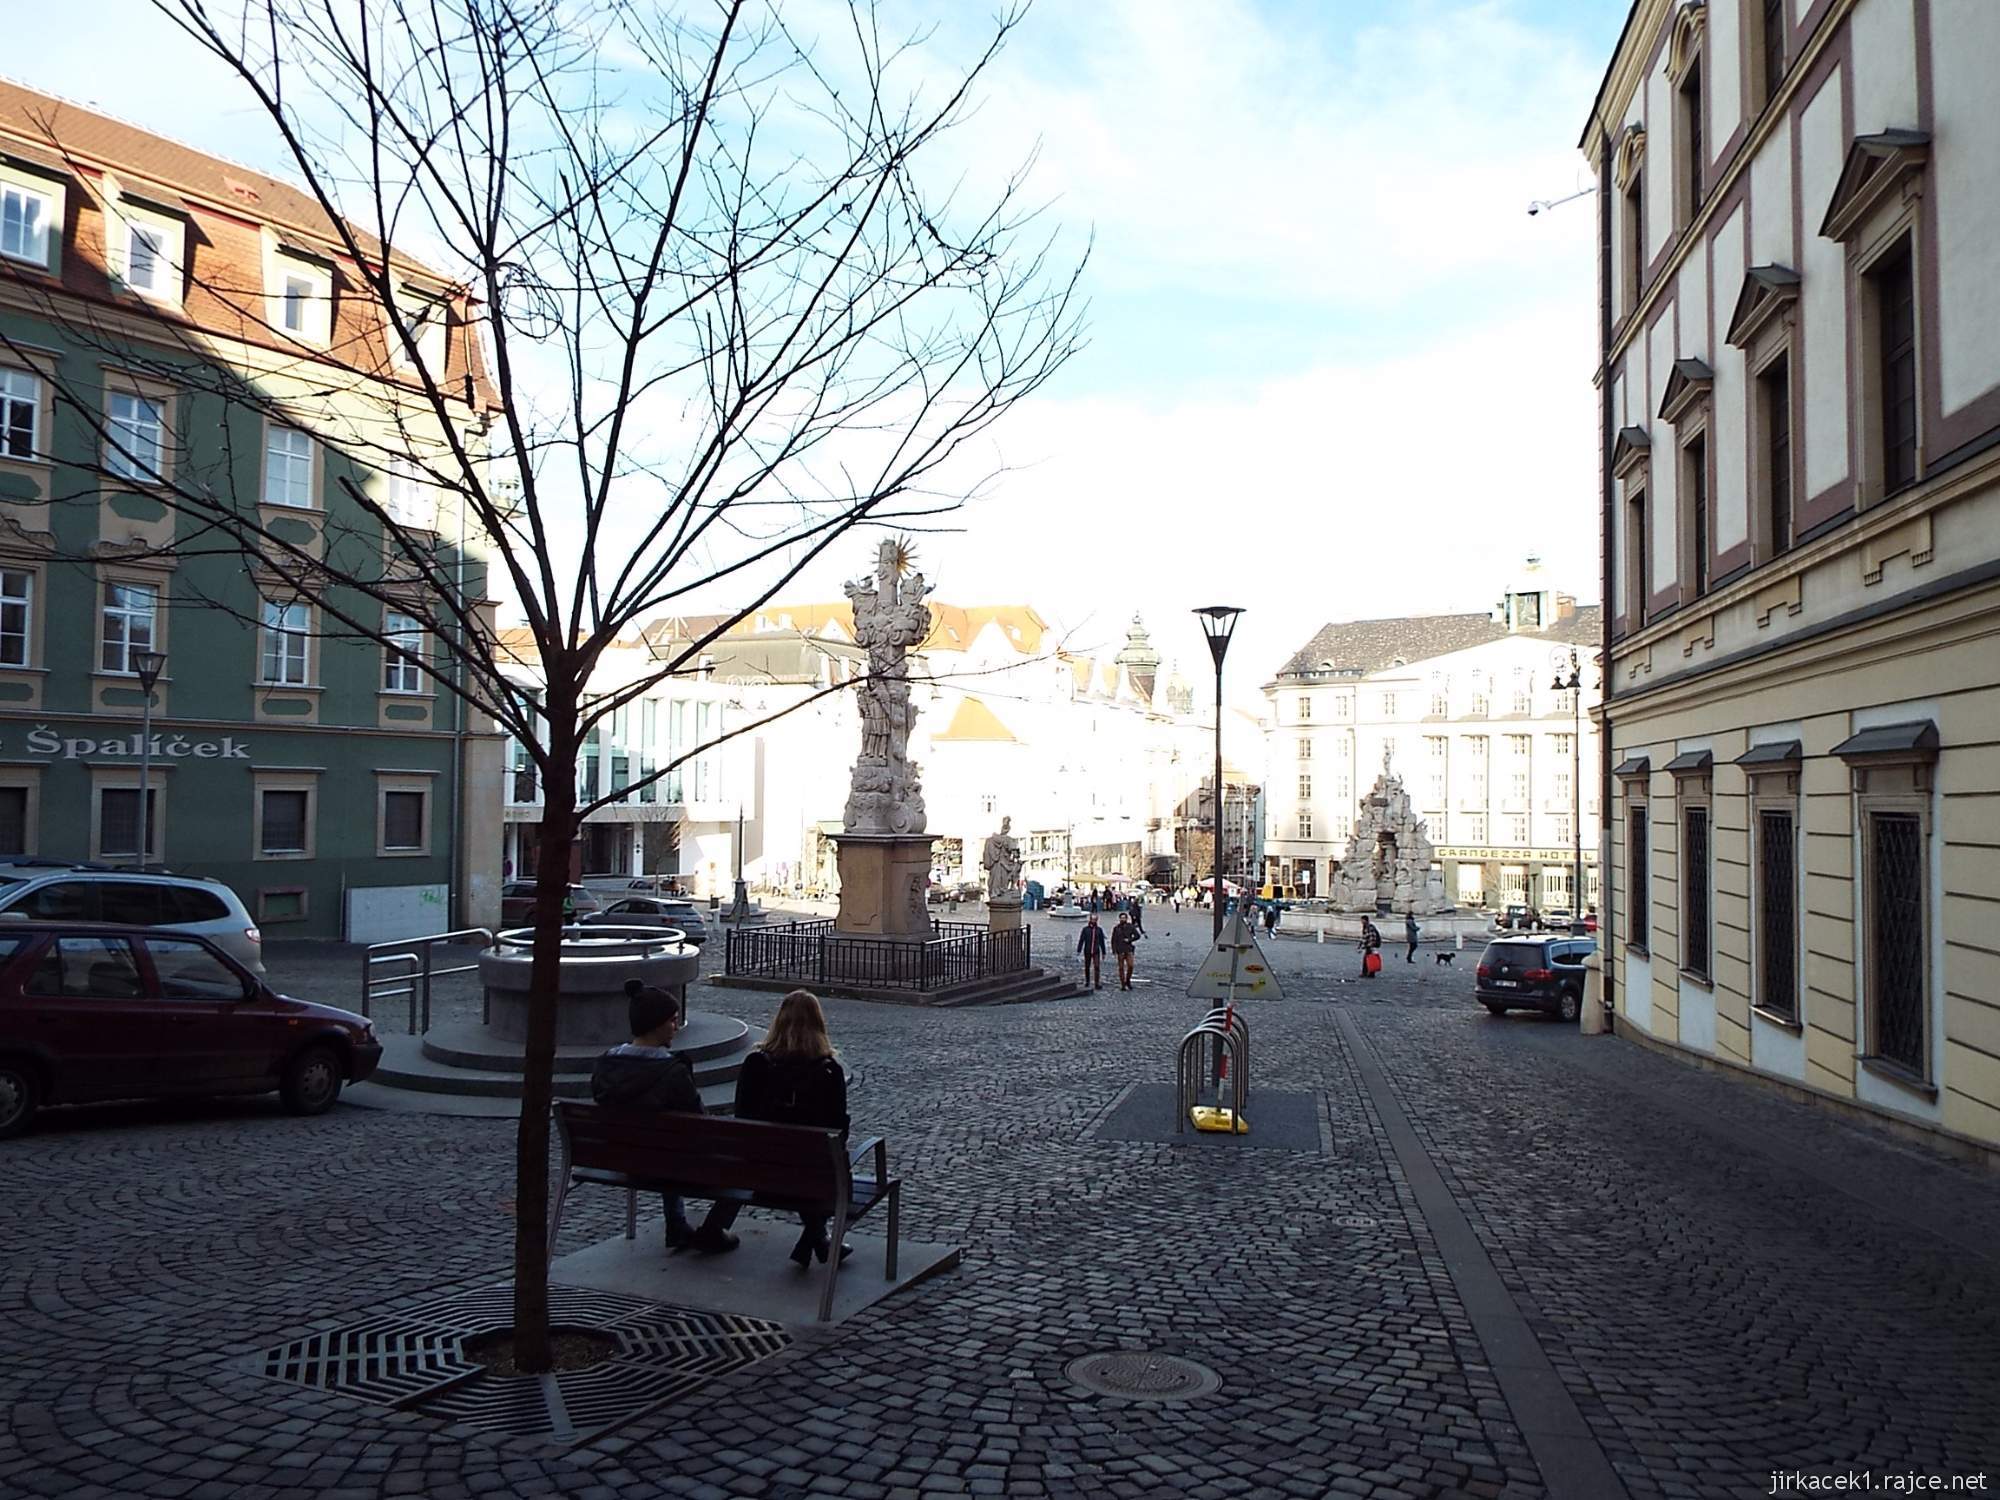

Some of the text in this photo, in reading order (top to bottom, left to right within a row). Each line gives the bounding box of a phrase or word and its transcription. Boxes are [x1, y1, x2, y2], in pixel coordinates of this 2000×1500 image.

[27, 724, 251, 759] Špalíček
[1438, 848, 1593, 861] GRANDEZZA HOTL
